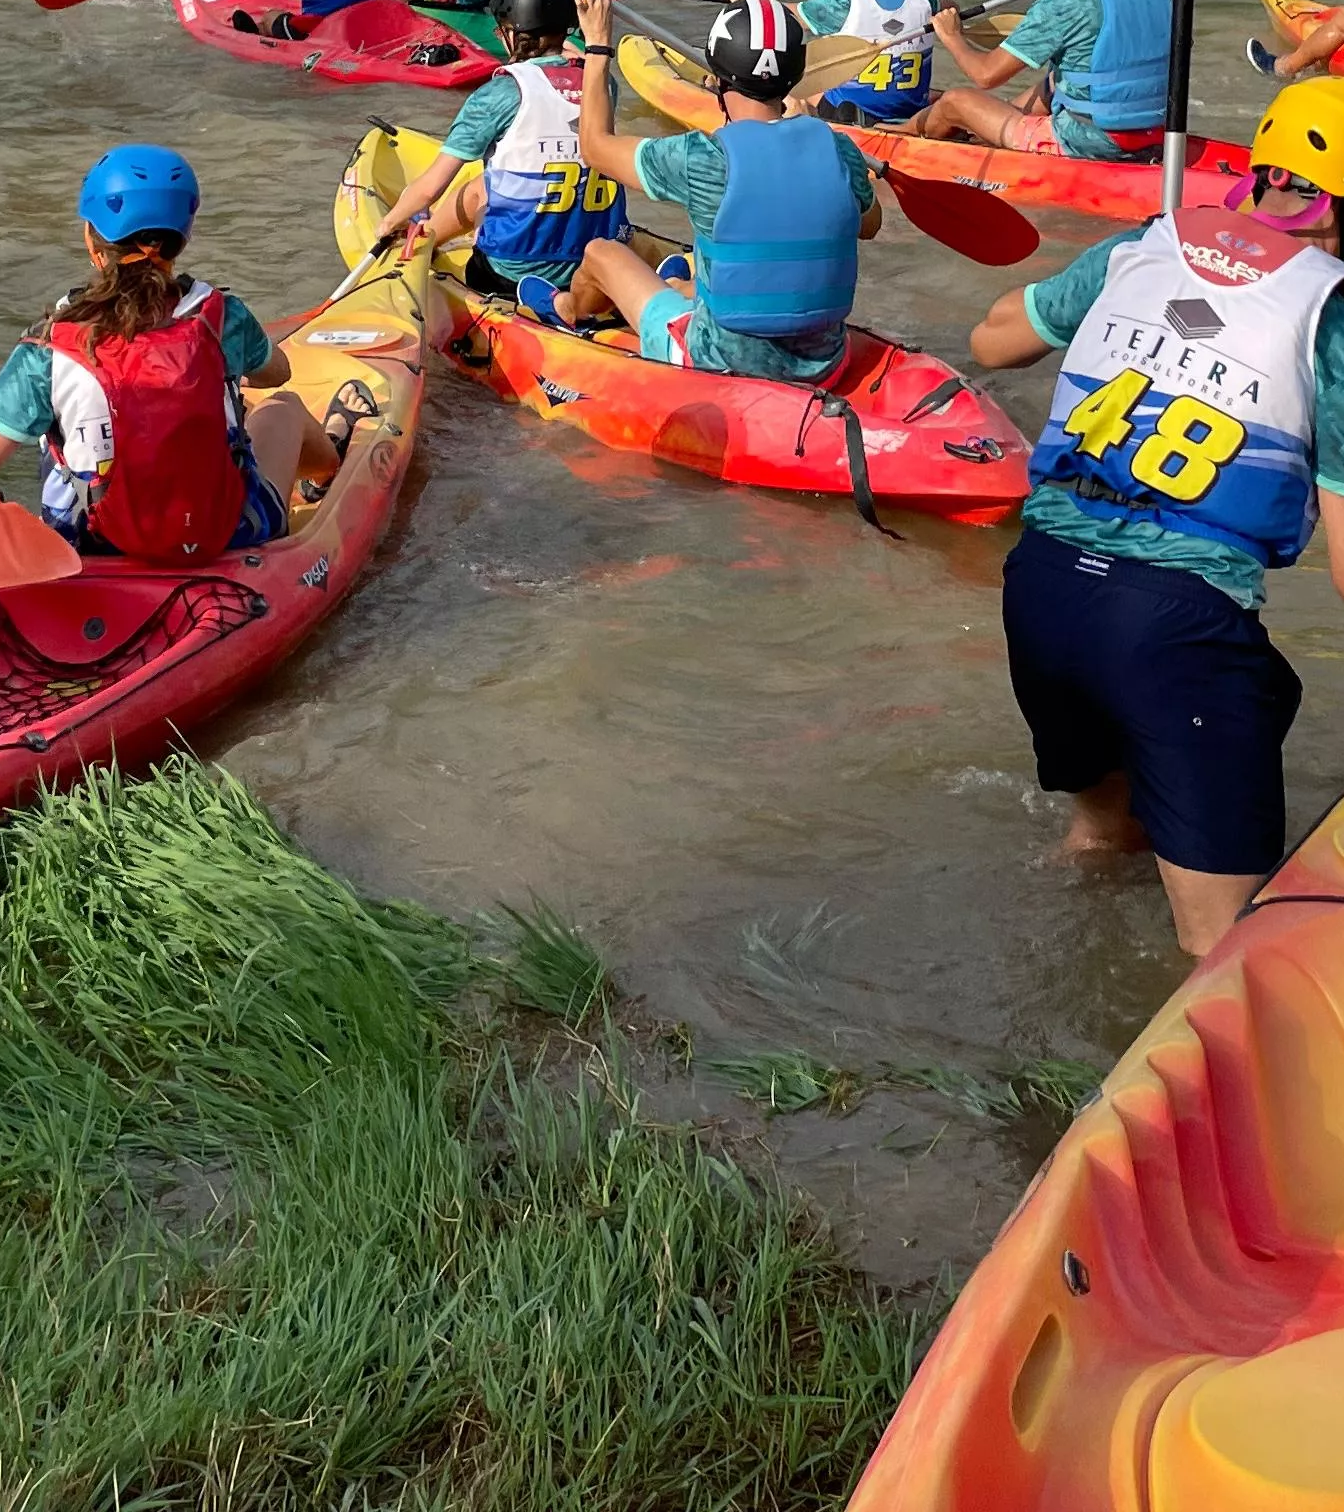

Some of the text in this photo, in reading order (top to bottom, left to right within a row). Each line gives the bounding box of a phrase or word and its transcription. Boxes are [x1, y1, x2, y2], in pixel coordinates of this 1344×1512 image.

[751, 48, 780, 77] A
[858, 52, 923, 91] 43
[536, 161, 618, 214] 36
[1182, 241, 1260, 282] ROGLES
[1102, 321, 1260, 404] TEJERA
[1064, 367, 1248, 506] 48
[302, 555, 329, 588] DISCO
